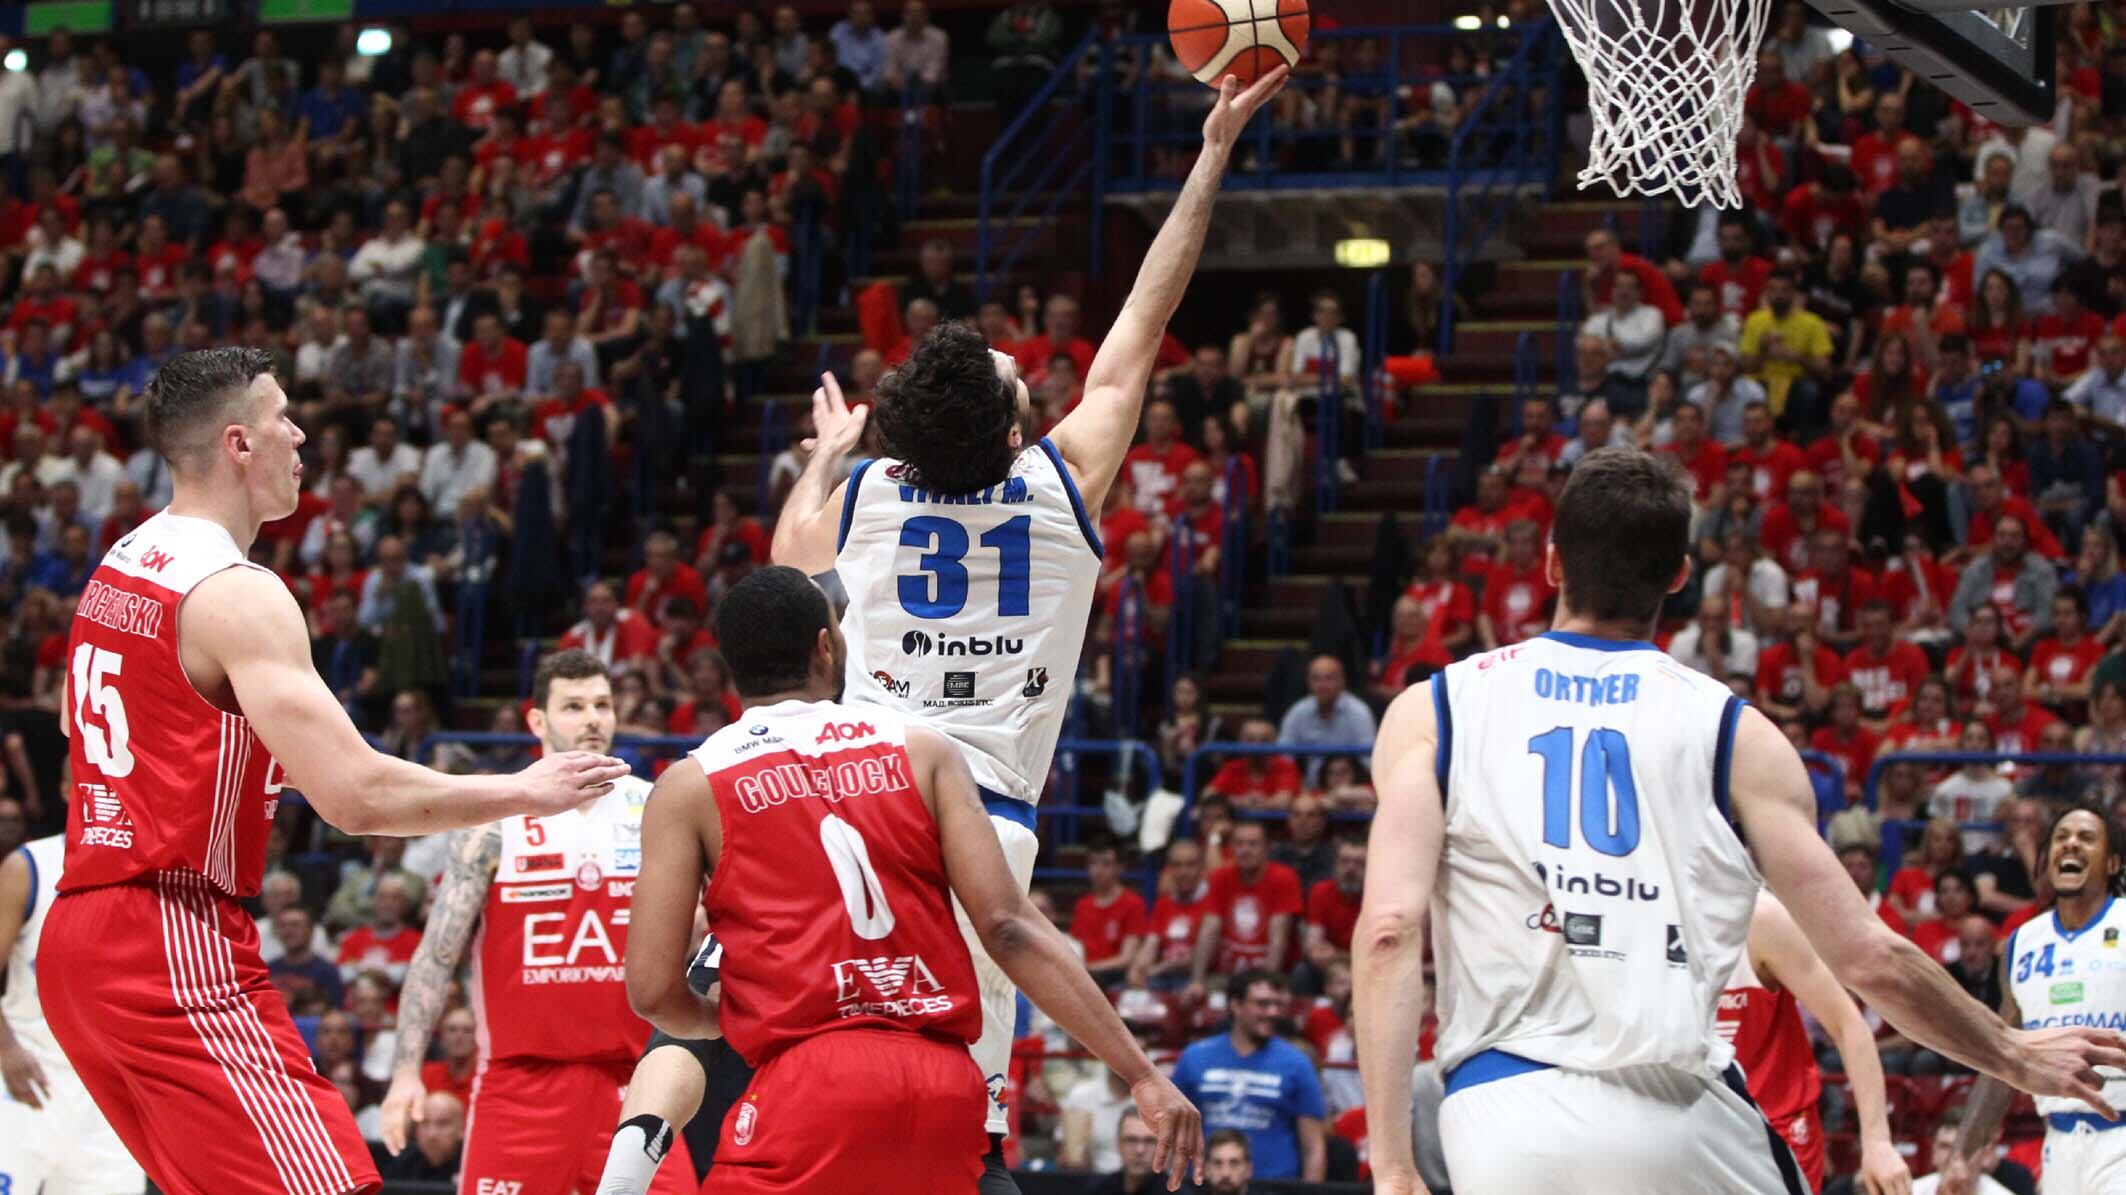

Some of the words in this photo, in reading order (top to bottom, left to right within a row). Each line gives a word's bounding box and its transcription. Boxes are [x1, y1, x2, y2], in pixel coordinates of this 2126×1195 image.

[898, 515, 1032, 619] 31
[938, 632, 1024, 656] inblu
[1535, 668, 1640, 707] ORTNER
[72, 642, 135, 778] 15
[815, 721, 876, 745] AON
[1528, 726, 1641, 858] 10
[523, 816, 546, 847] 5
[820, 813, 896, 940] 0
[1556, 864, 1660, 902] inblu
[2016, 943, 2056, 984] 34
[838, 995, 954, 1019] TIMEPIECES
[477, 1177, 523, 1195] EA7
